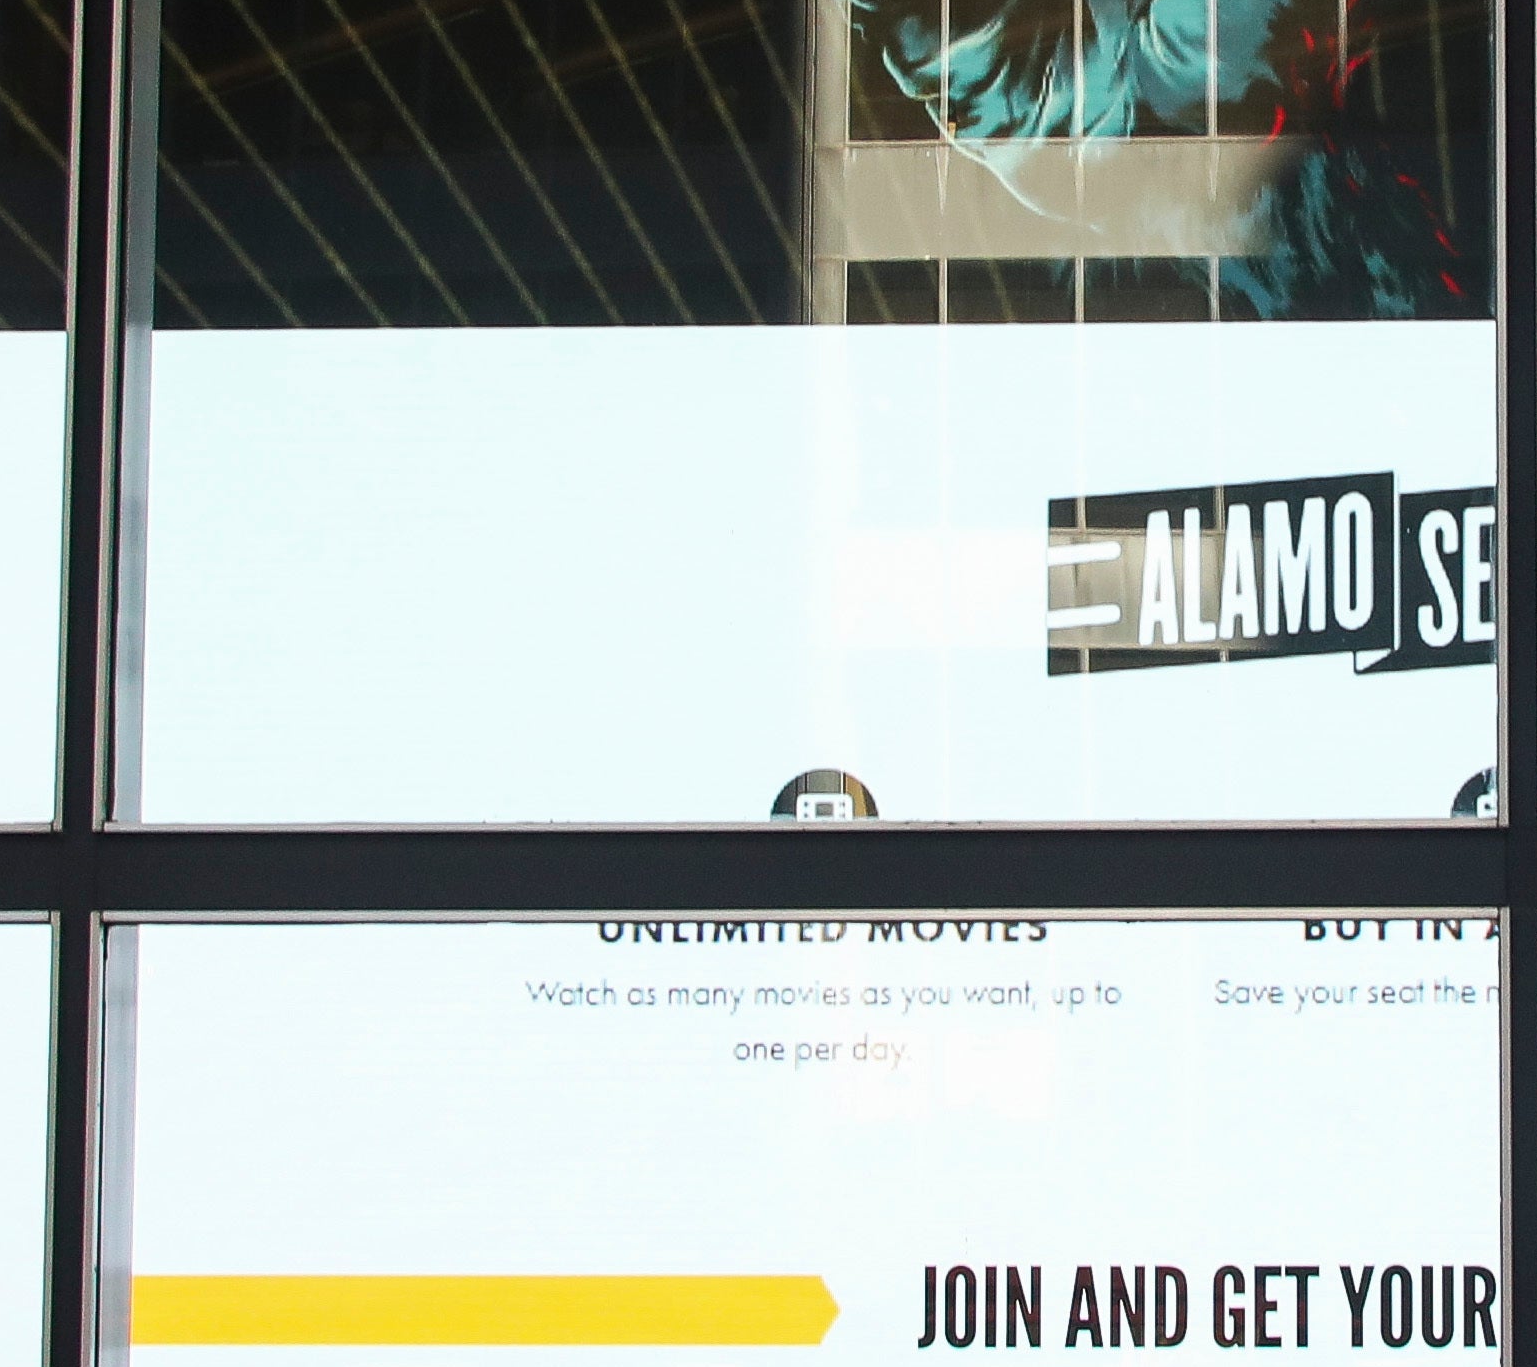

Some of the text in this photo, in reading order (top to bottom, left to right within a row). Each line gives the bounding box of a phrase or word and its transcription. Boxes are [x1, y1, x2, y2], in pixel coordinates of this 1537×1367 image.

[1137, 491, 1373, 646] ALAMO
[525, 979, 1122, 1015] Watch as many movies as you want, up to
[1215, 979, 1284, 1004] Save
[1295, 986, 1358, 1014] your
[1368, 981, 1424, 1004] seat
[1434, 976, 1476, 1004] the
[733, 1042, 785, 1061] one
[795, 1042, 842, 1071] per
[918, 1266, 1041, 1348] JOIN
[1065, 1266, 1188, 1347] AND
[1213, 1265, 1319, 1348] GET
[1342, 1265, 1496, 1348] YOUR
